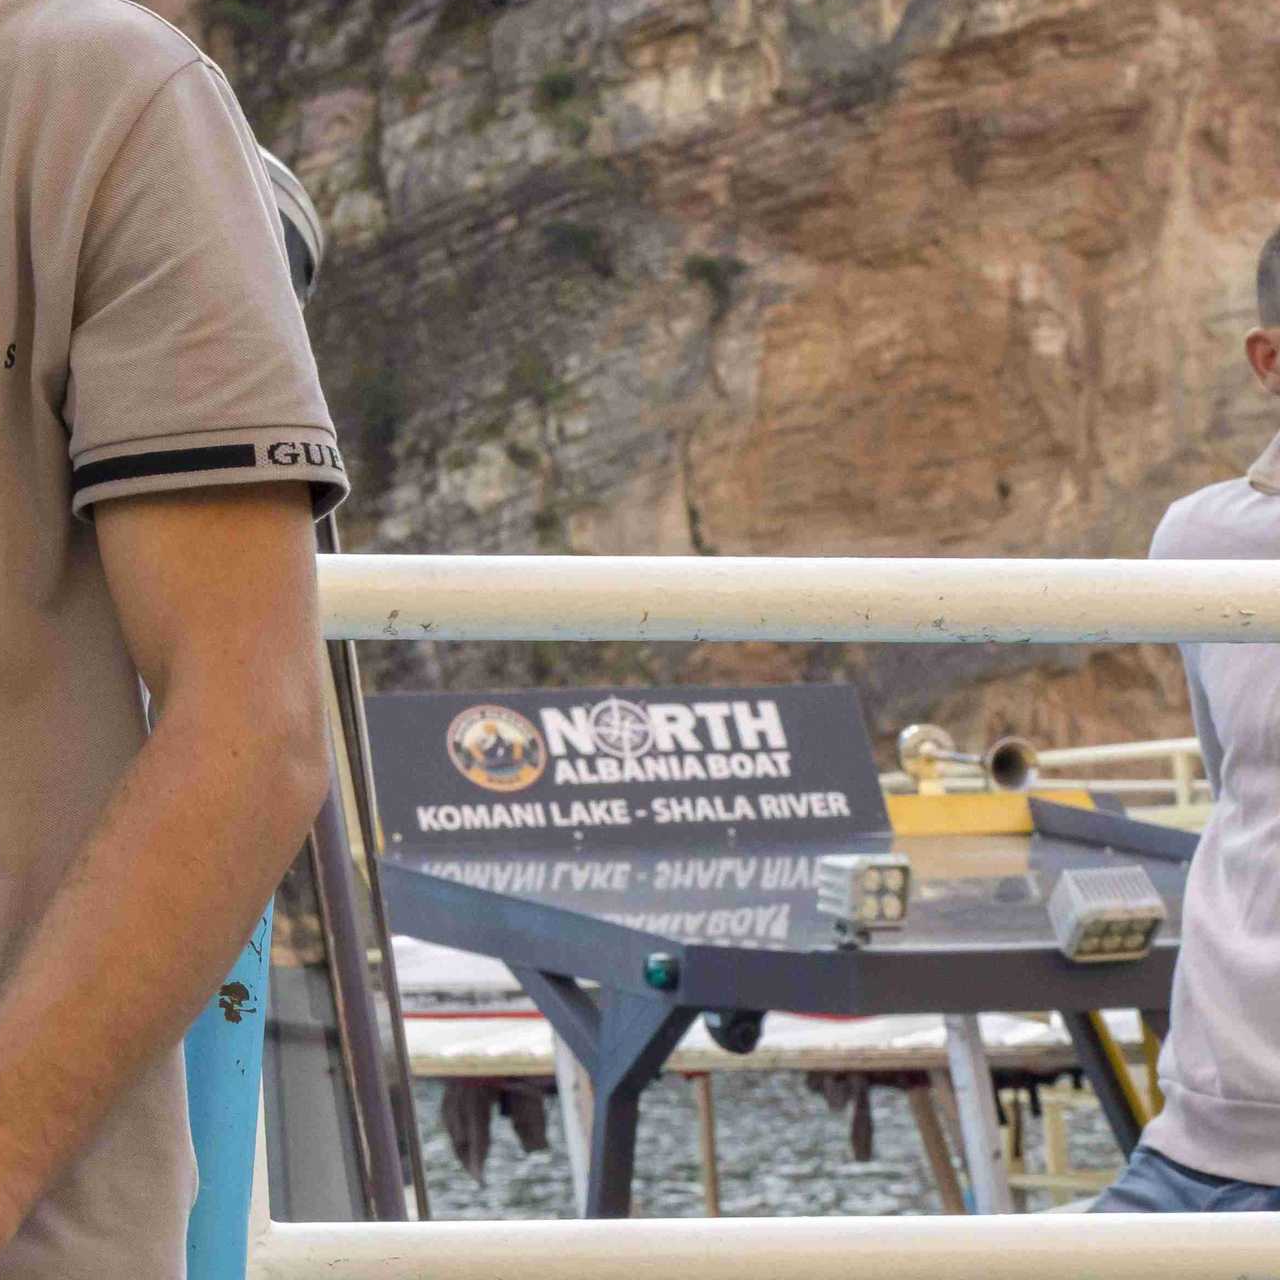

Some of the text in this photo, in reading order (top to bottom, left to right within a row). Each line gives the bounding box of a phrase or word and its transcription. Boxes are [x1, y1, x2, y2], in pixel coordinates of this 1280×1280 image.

[416, 803, 546, 832] KOMANI
[549, 798, 631, 827] LAKE
[651, 795, 757, 824] SHALA
[758, 791, 851, 820] RIVER
